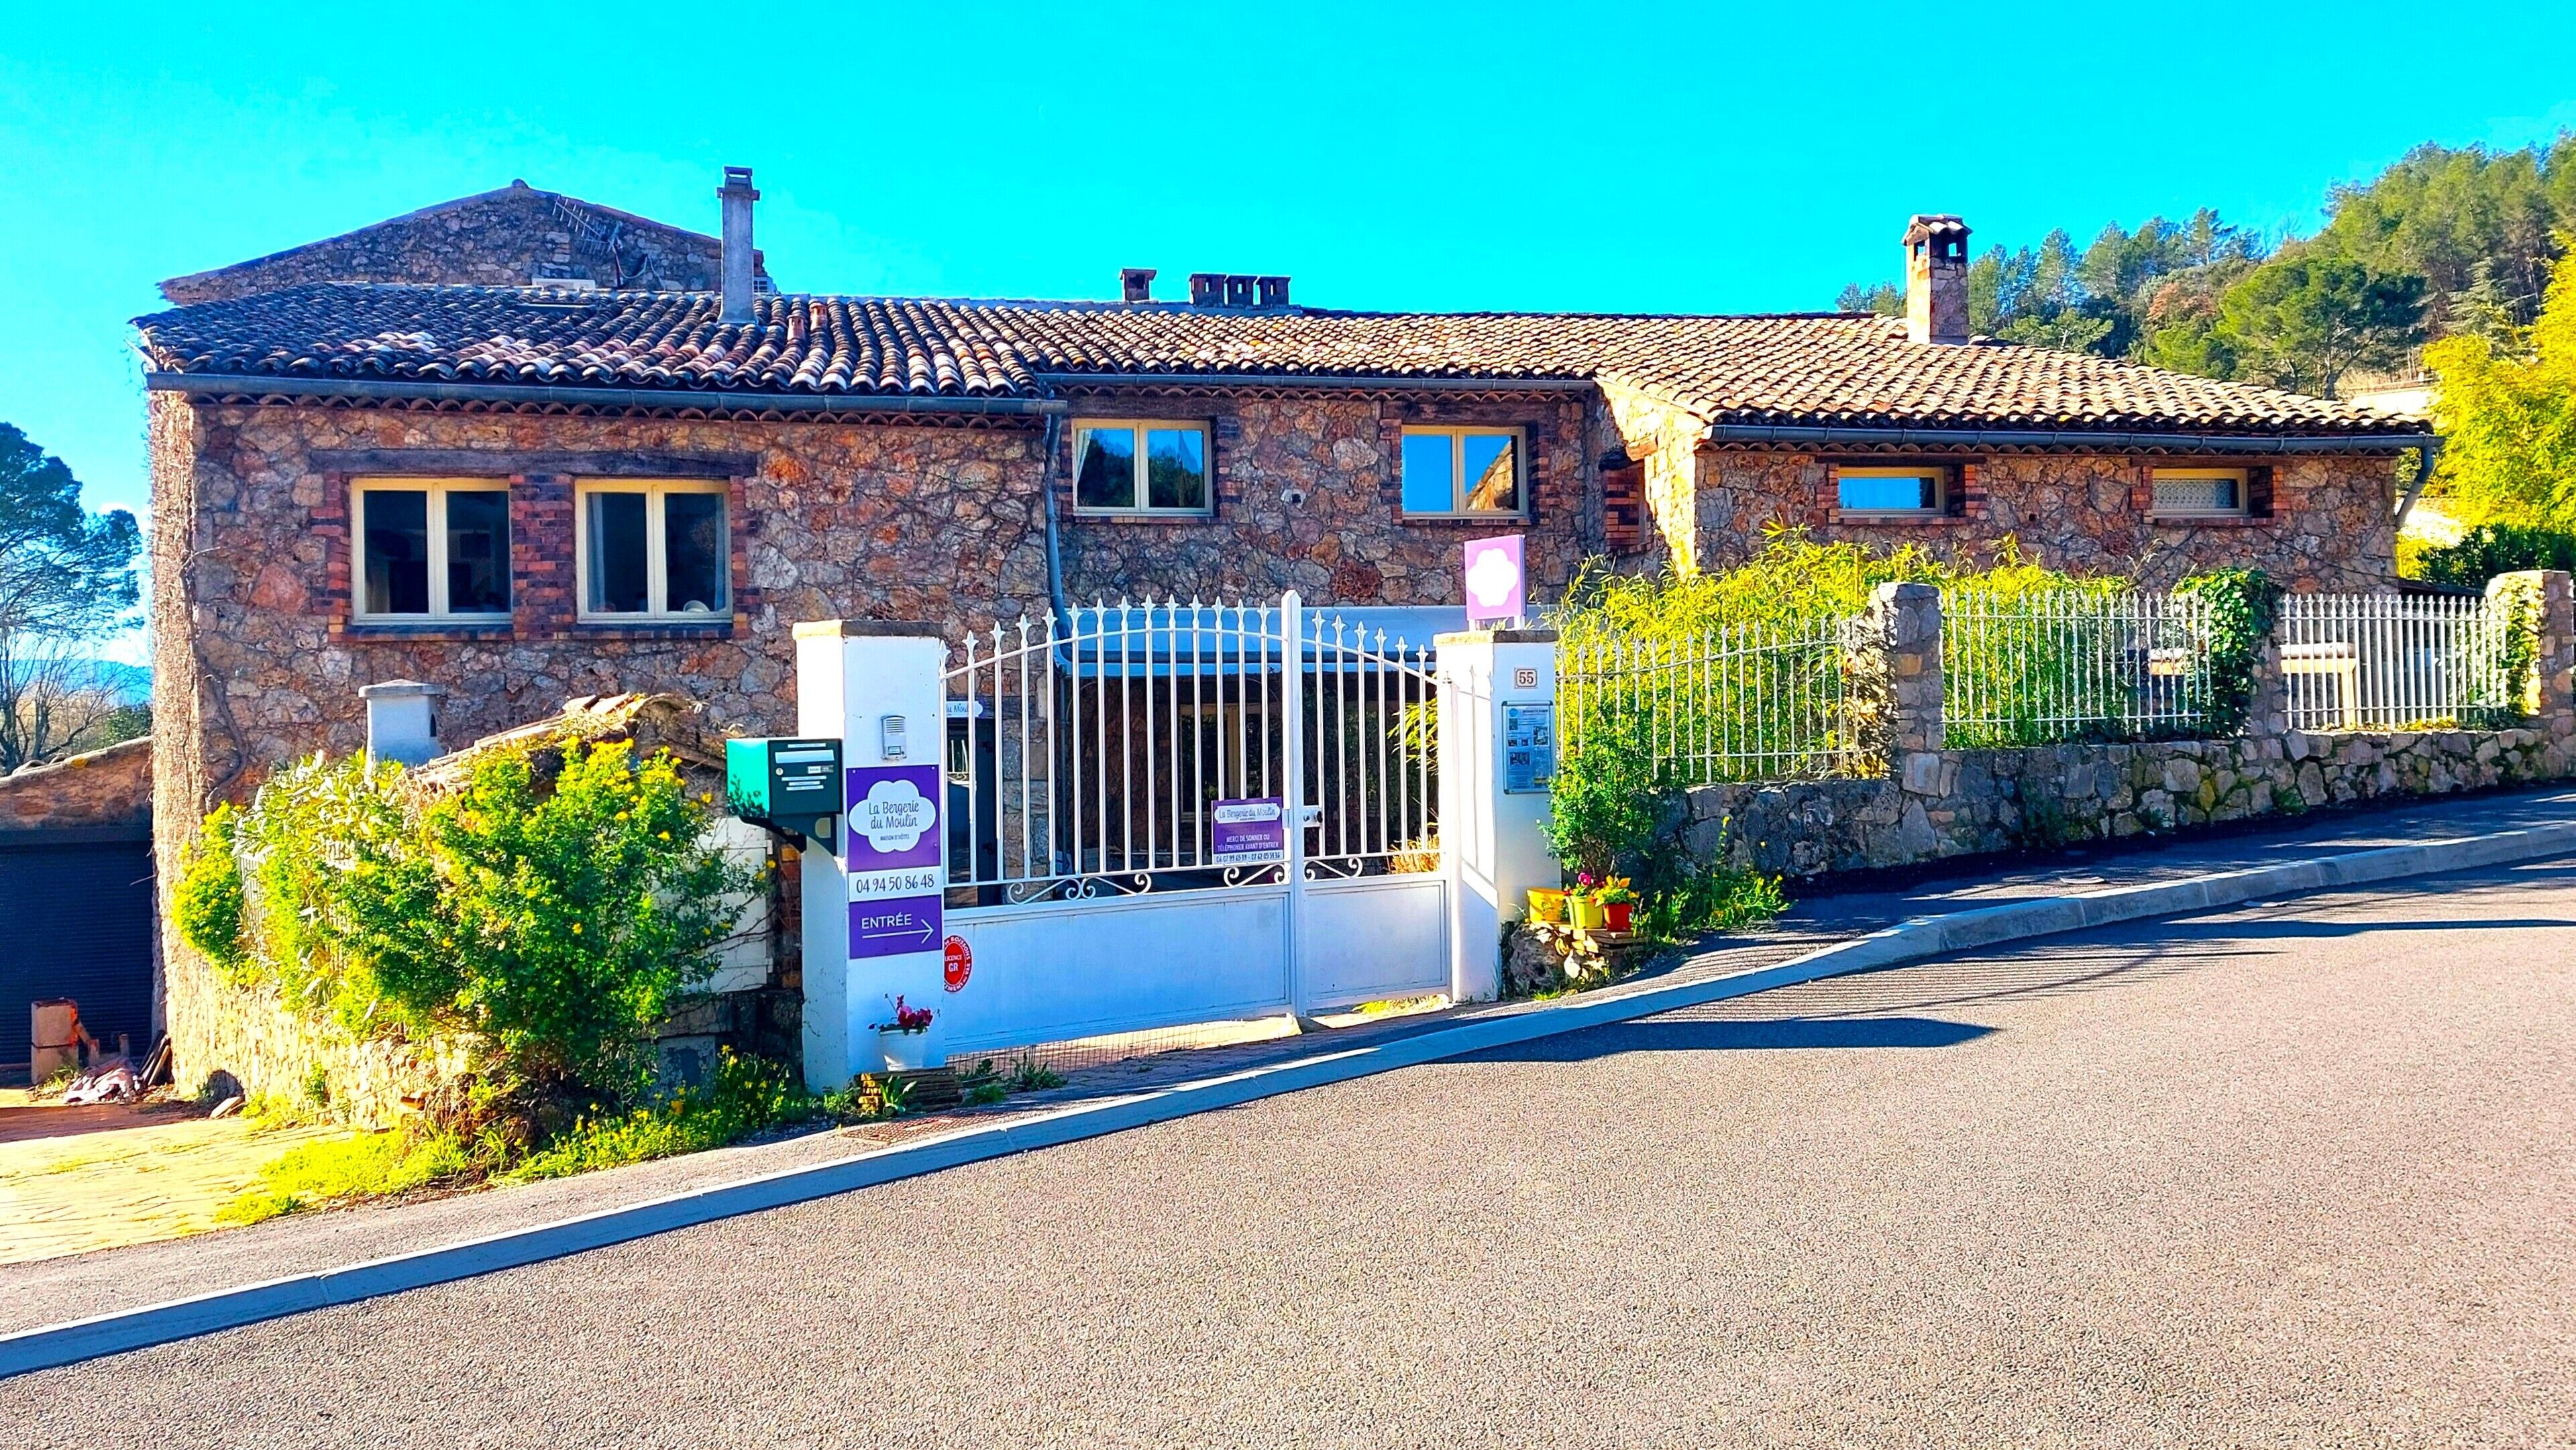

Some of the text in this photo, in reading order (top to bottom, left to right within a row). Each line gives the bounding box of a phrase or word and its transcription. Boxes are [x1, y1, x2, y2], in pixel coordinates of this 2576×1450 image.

[1519, 671, 1534, 684] 55
[869, 800, 919, 816] La Bergerie
[1219, 807, 1275, 820] La Bergerie du Moulin
[871, 814, 918, 829] du Moulin
[856, 874, 934, 893] 04 94 50 86 48
[861, 912, 912, 930] ENTRÉE
[951, 936, 971, 960] BOISSONS
[948, 962, 959, 972] GR
